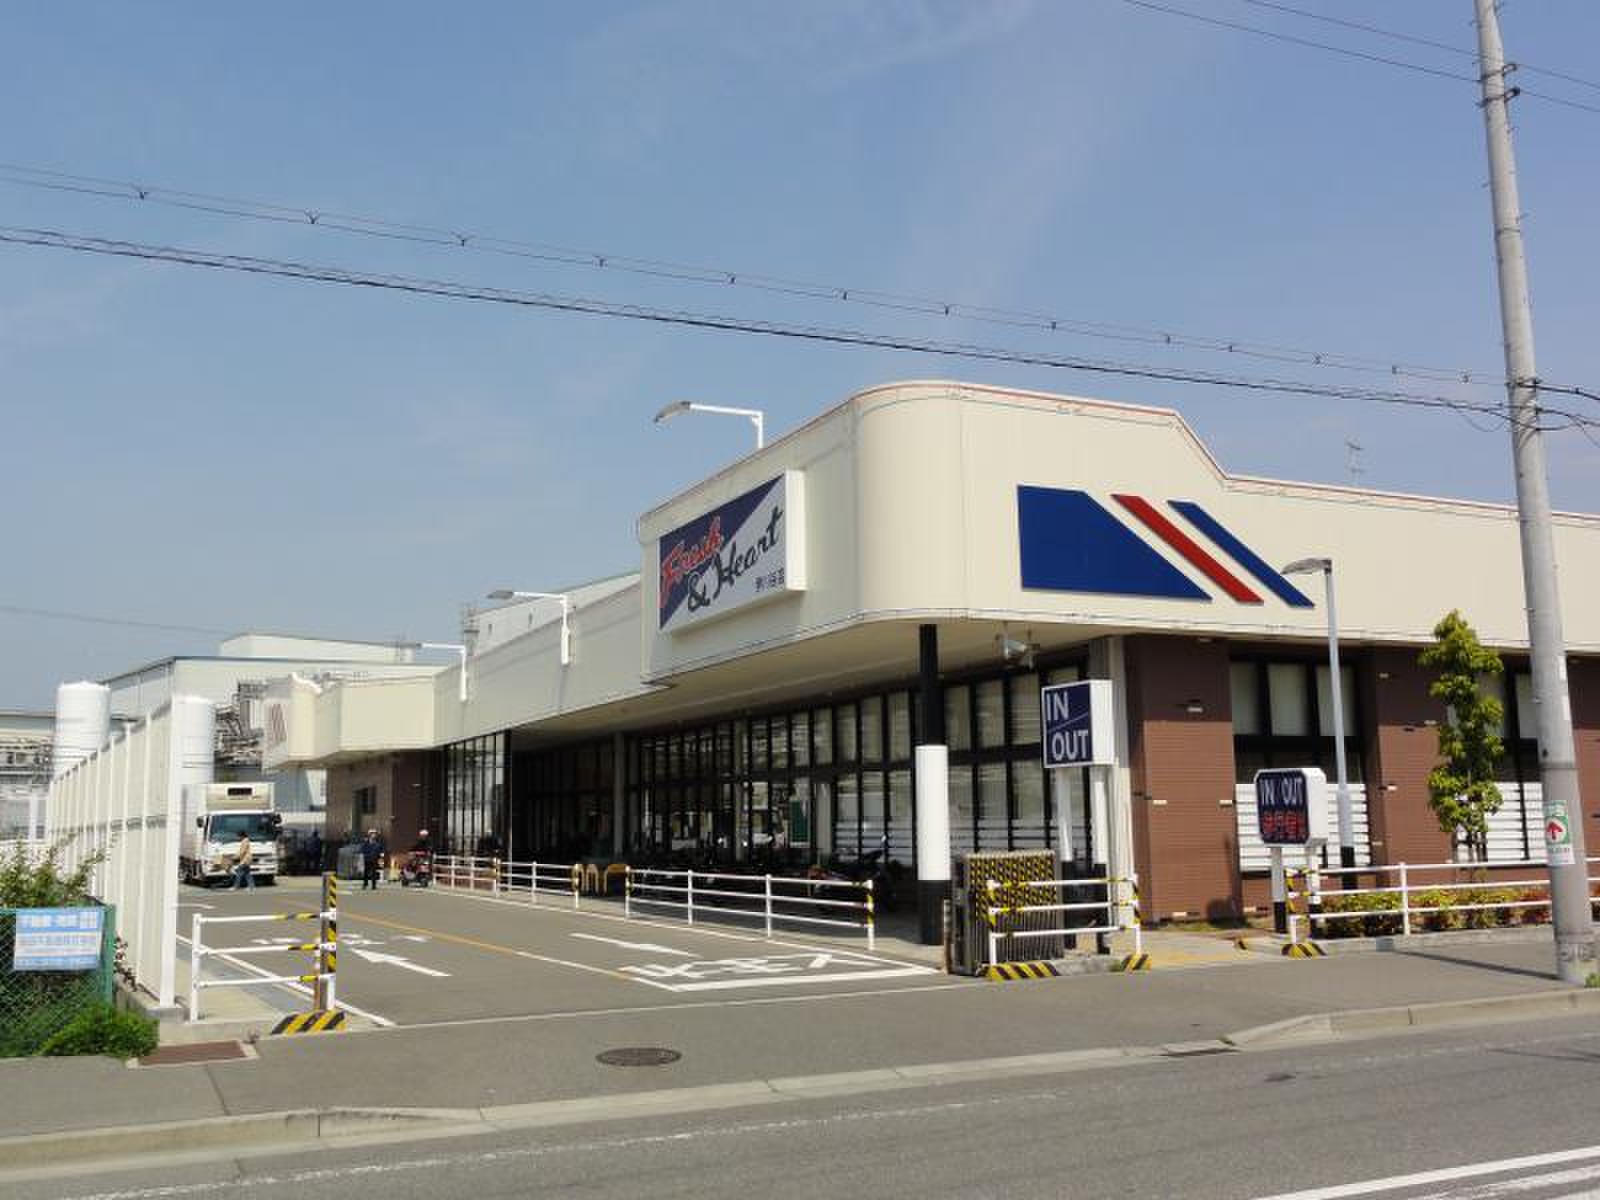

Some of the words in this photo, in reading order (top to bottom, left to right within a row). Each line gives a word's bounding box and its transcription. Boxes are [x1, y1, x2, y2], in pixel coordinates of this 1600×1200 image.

[660, 516, 724, 608] Fresh
[688, 572, 710, 612] &
[711, 506, 783, 599] Heart
[1046, 690, 1069, 722] IN
[1052, 730, 1089, 761] OUT
[1259, 777, 1275, 806] IN
[1281, 776, 1303, 806] OUT
